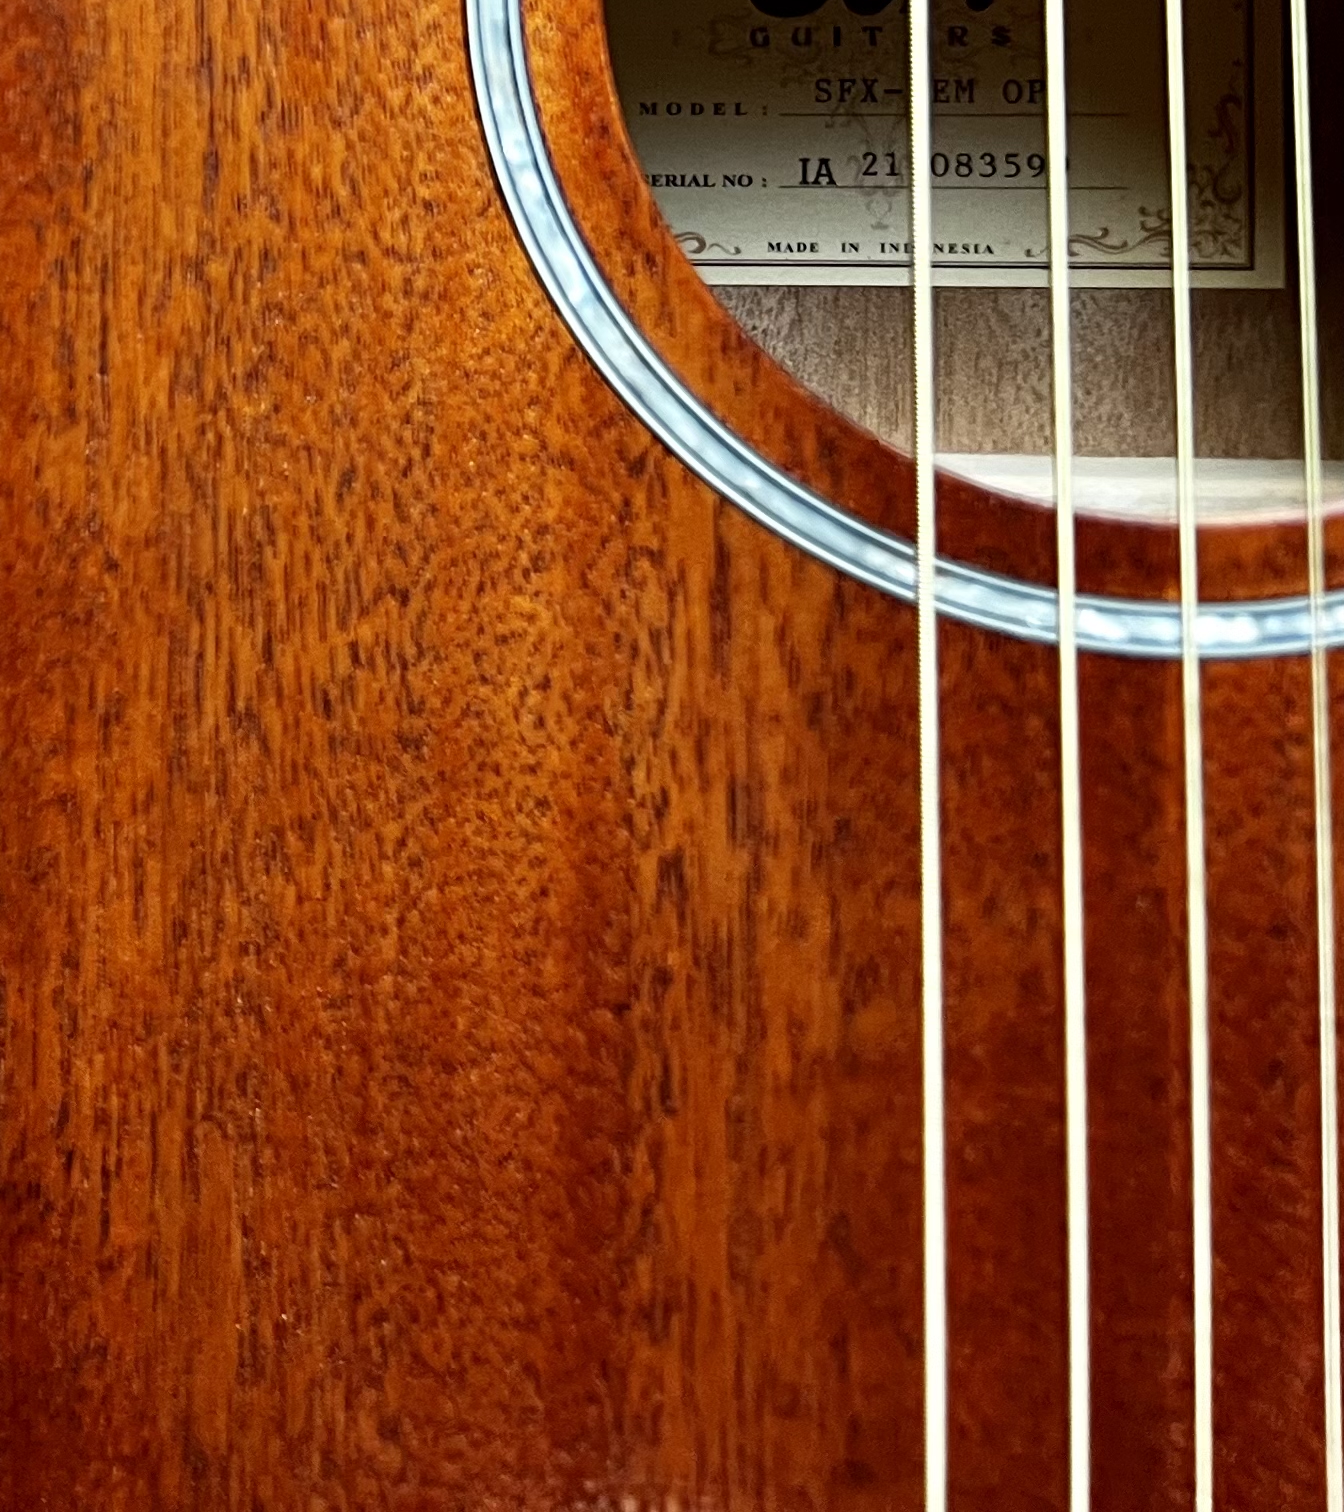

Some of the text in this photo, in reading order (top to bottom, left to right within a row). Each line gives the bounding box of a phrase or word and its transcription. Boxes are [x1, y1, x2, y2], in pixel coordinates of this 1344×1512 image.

[749, 25, 1013, 48] GUITRS
[814, 78, 1047, 104] SFX-EM OP
[798, 151, 1070, 186] IA 2108359
[767, 241, 820, 254] MADE
[840, 242, 860, 254] IN
